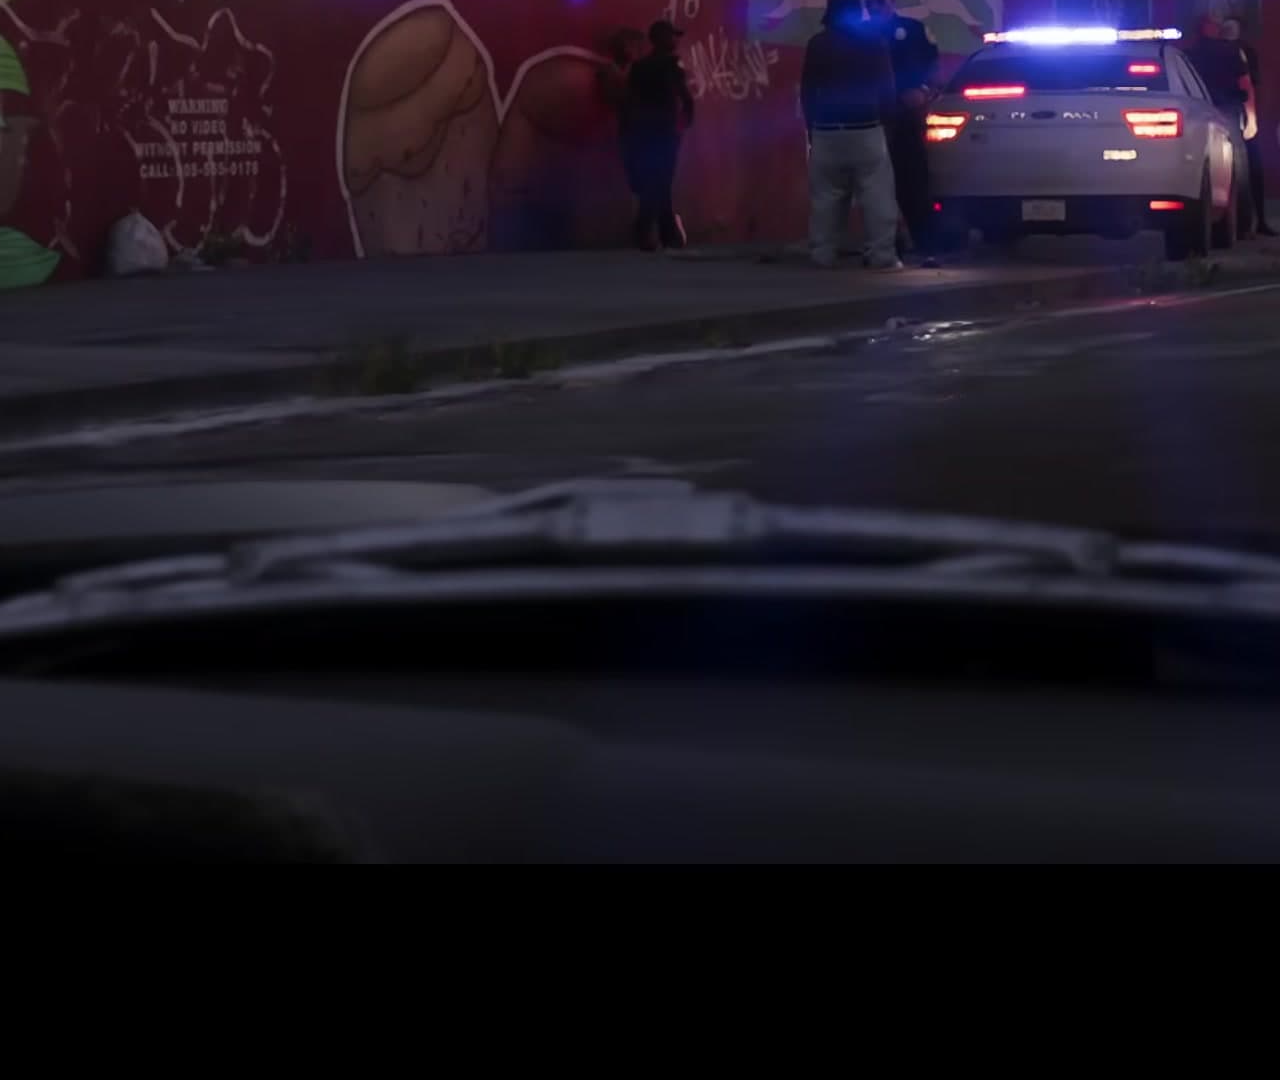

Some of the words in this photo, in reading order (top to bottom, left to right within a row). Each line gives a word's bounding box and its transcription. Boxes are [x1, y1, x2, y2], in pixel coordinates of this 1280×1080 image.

[167, 98, 229, 115] WARNING
[170, 119, 188, 136] NO
[191, 119, 226, 136] VIDEO
